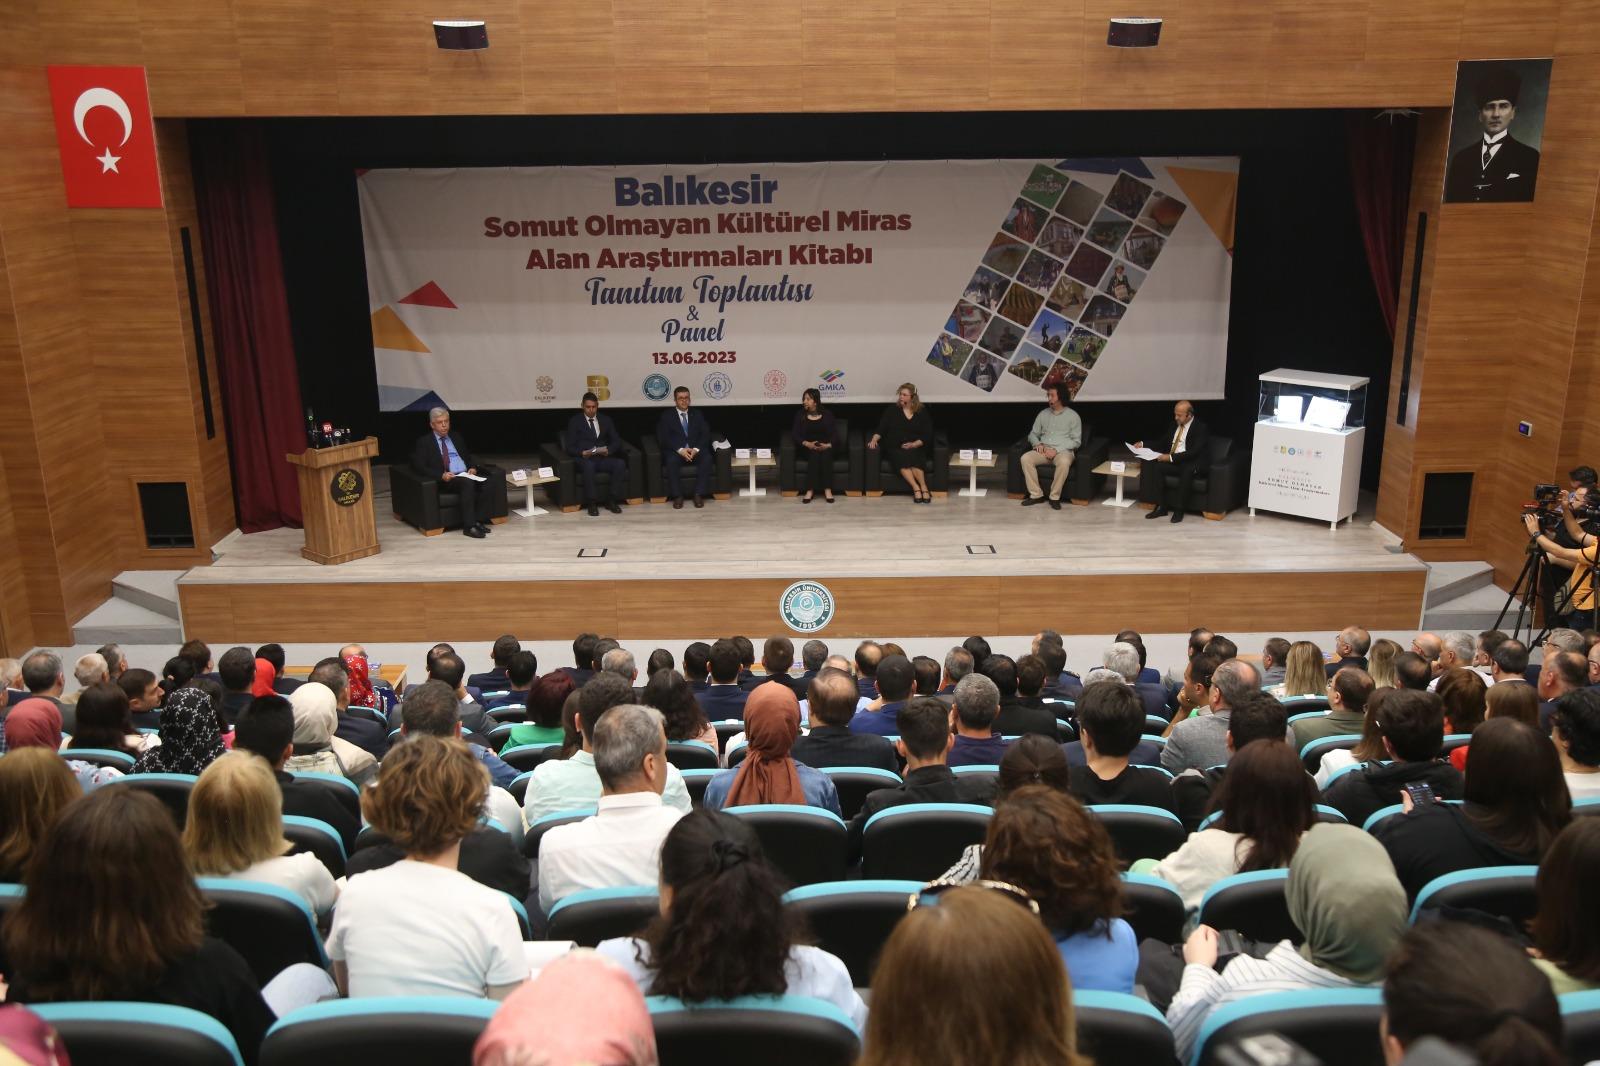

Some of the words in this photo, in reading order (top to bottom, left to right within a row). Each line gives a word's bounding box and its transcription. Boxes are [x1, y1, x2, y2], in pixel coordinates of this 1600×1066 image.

[614, 174, 778, 207] Balıkesir
[484, 215, 579, 239] Somut
[585, 214, 711, 240] Olmayan
[717, 211, 830, 235] Kültürel
[837, 209, 912, 232] Miras
[526, 248, 590, 270] Alan
[596, 245, 783, 272] Araştırmaları
[789, 243, 873, 265] Kitabı
[584, 276, 685, 306] Tanıtım
[692, 274, 814, 312] Toplantısı
[687, 305, 699, 321] &
[661, 319, 725, 343] Panel
[652, 351, 737, 364] 13.06.2023
